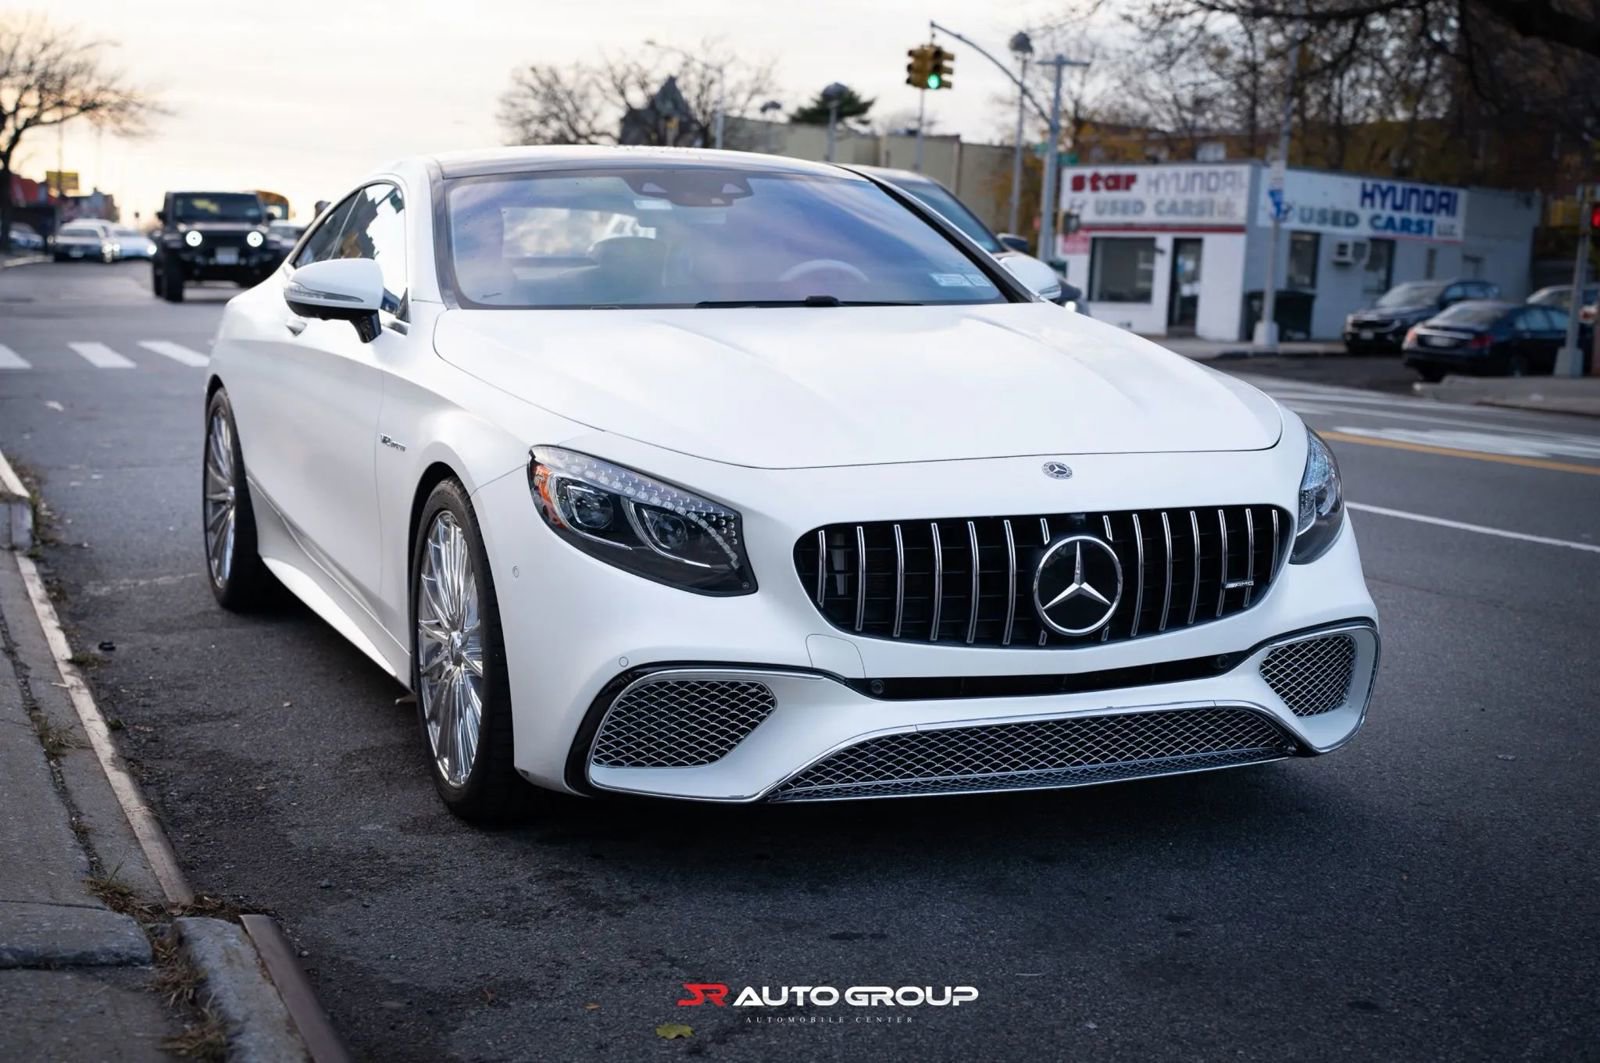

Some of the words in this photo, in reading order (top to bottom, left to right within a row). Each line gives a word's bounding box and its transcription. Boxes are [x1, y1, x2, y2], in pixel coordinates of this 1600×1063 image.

[1072, 172, 1137, 192] star
[1094, 198, 1146, 216] USED
[1359, 182, 1459, 217] HYUNDAI
[1298, 206, 1360, 228] USED
[1369, 213, 1434, 237] CARS!
